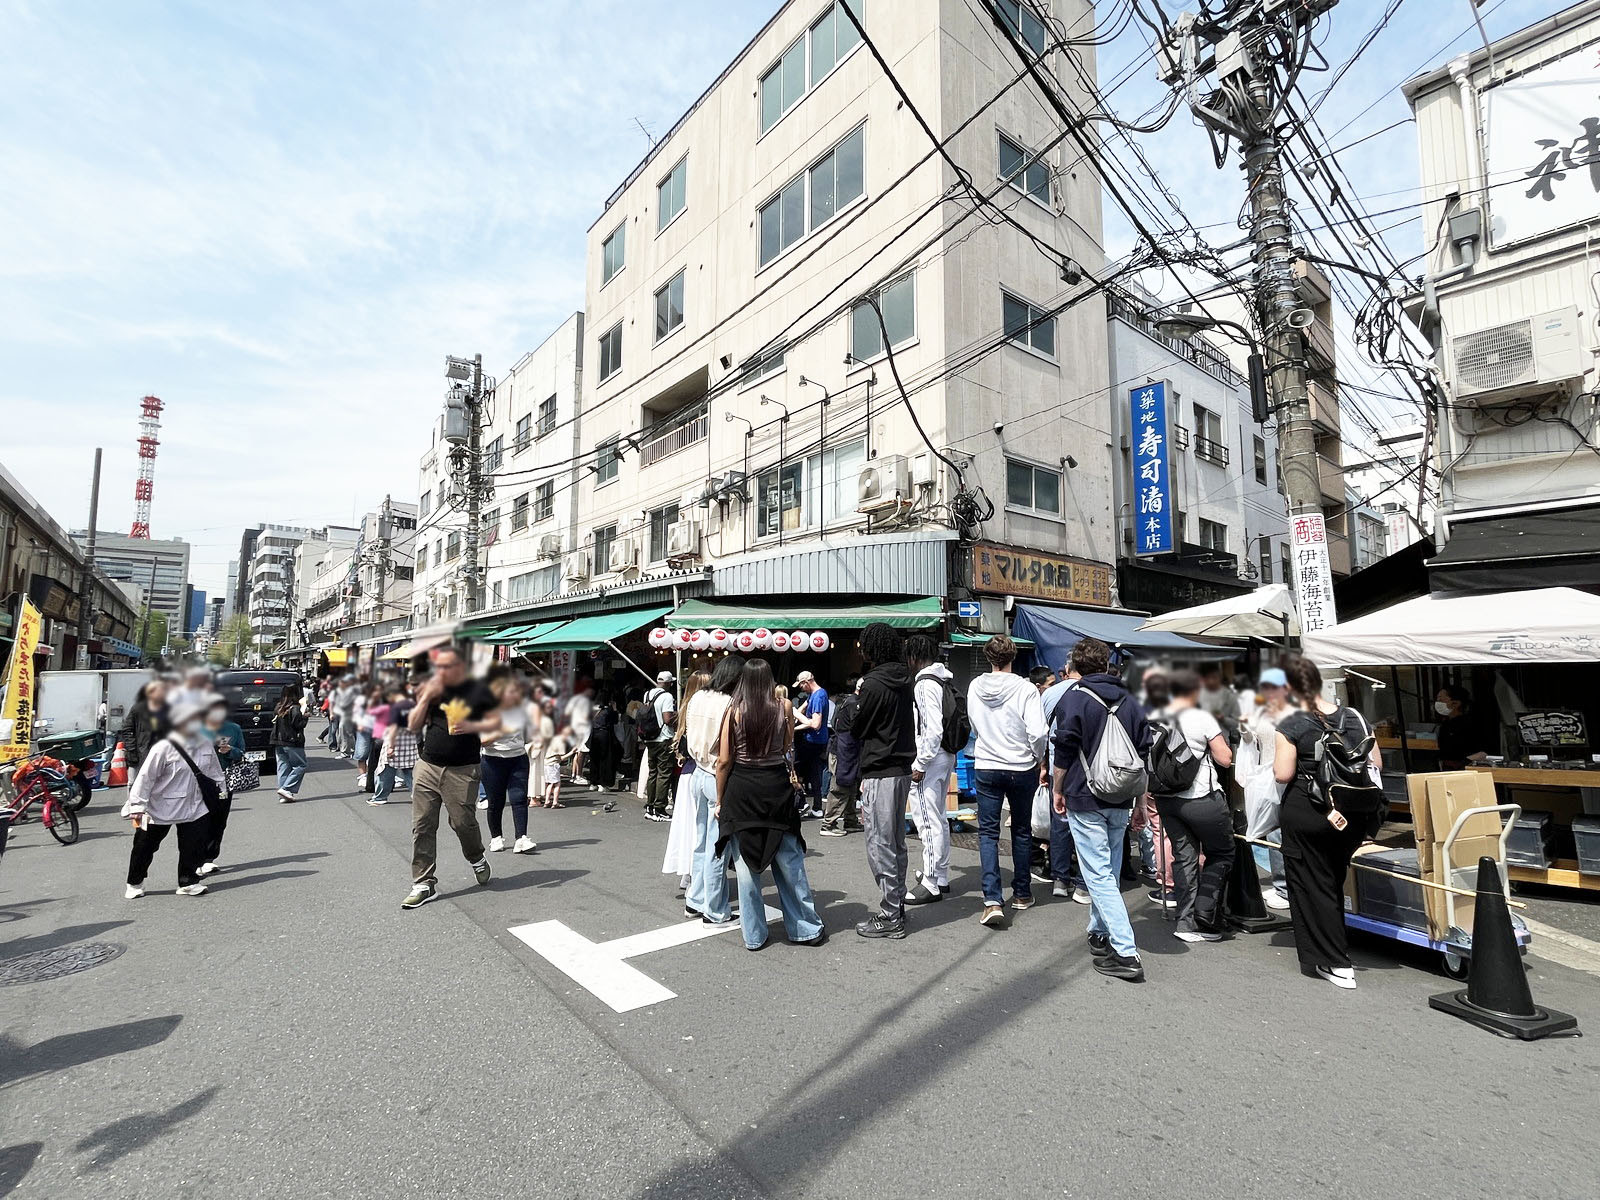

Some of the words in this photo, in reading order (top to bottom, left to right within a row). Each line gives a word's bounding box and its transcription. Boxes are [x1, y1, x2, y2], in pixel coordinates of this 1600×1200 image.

[995, 554, 1071, 589] マルタ食品
[1298, 549, 1324, 633] 伊藤海苔店
